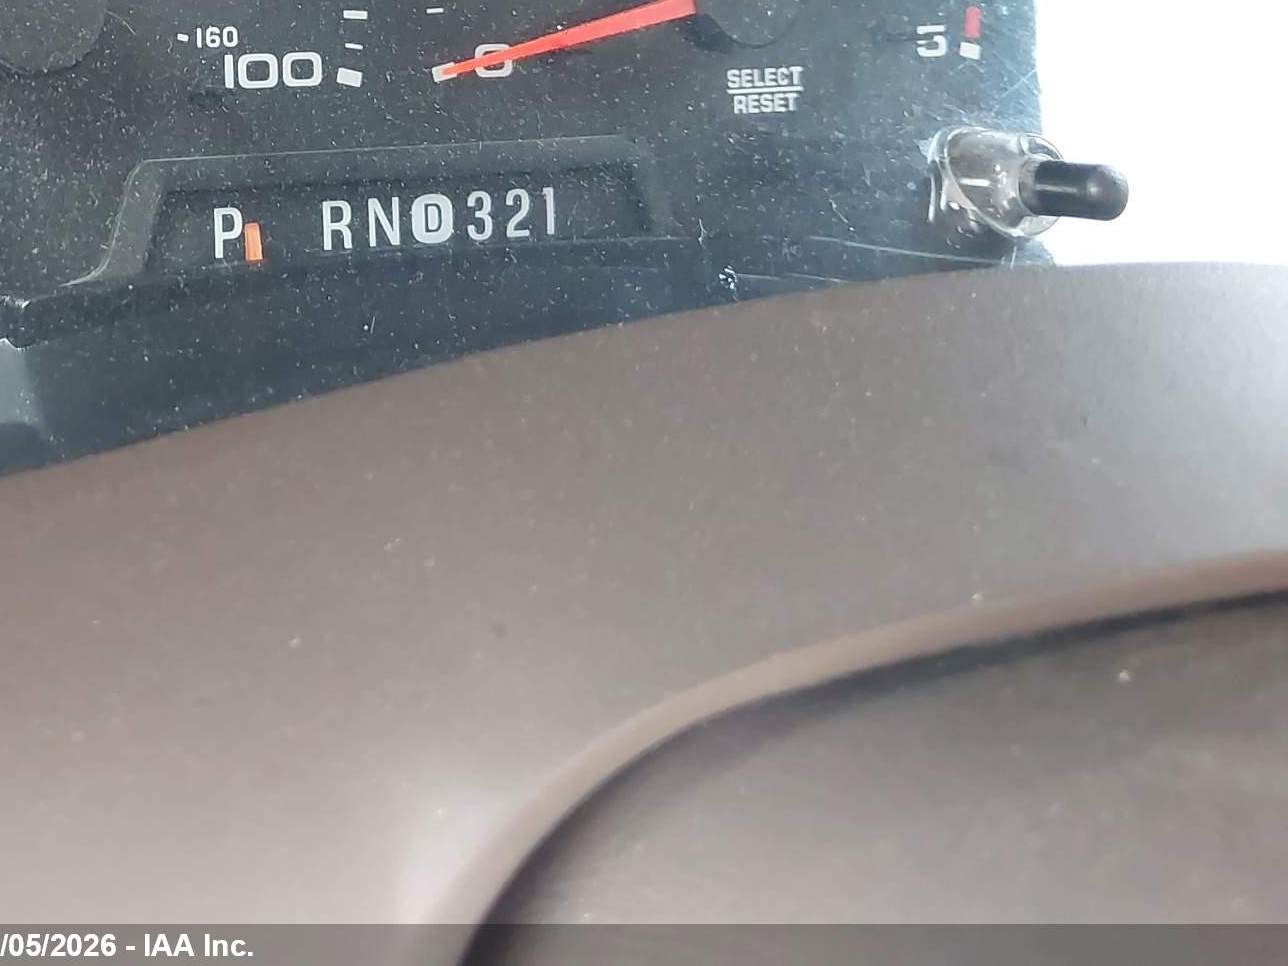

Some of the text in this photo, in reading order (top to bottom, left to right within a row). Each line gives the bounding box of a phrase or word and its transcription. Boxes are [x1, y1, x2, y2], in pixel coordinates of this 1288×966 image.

[194, 25, 239, 48] 160
[916, 24, 948, 59] 5
[223, 52, 323, 90] 100
[727, 66, 803, 89] SELECT
[733, 92, 799, 113] RESET
[213, 207, 244, 259] P
